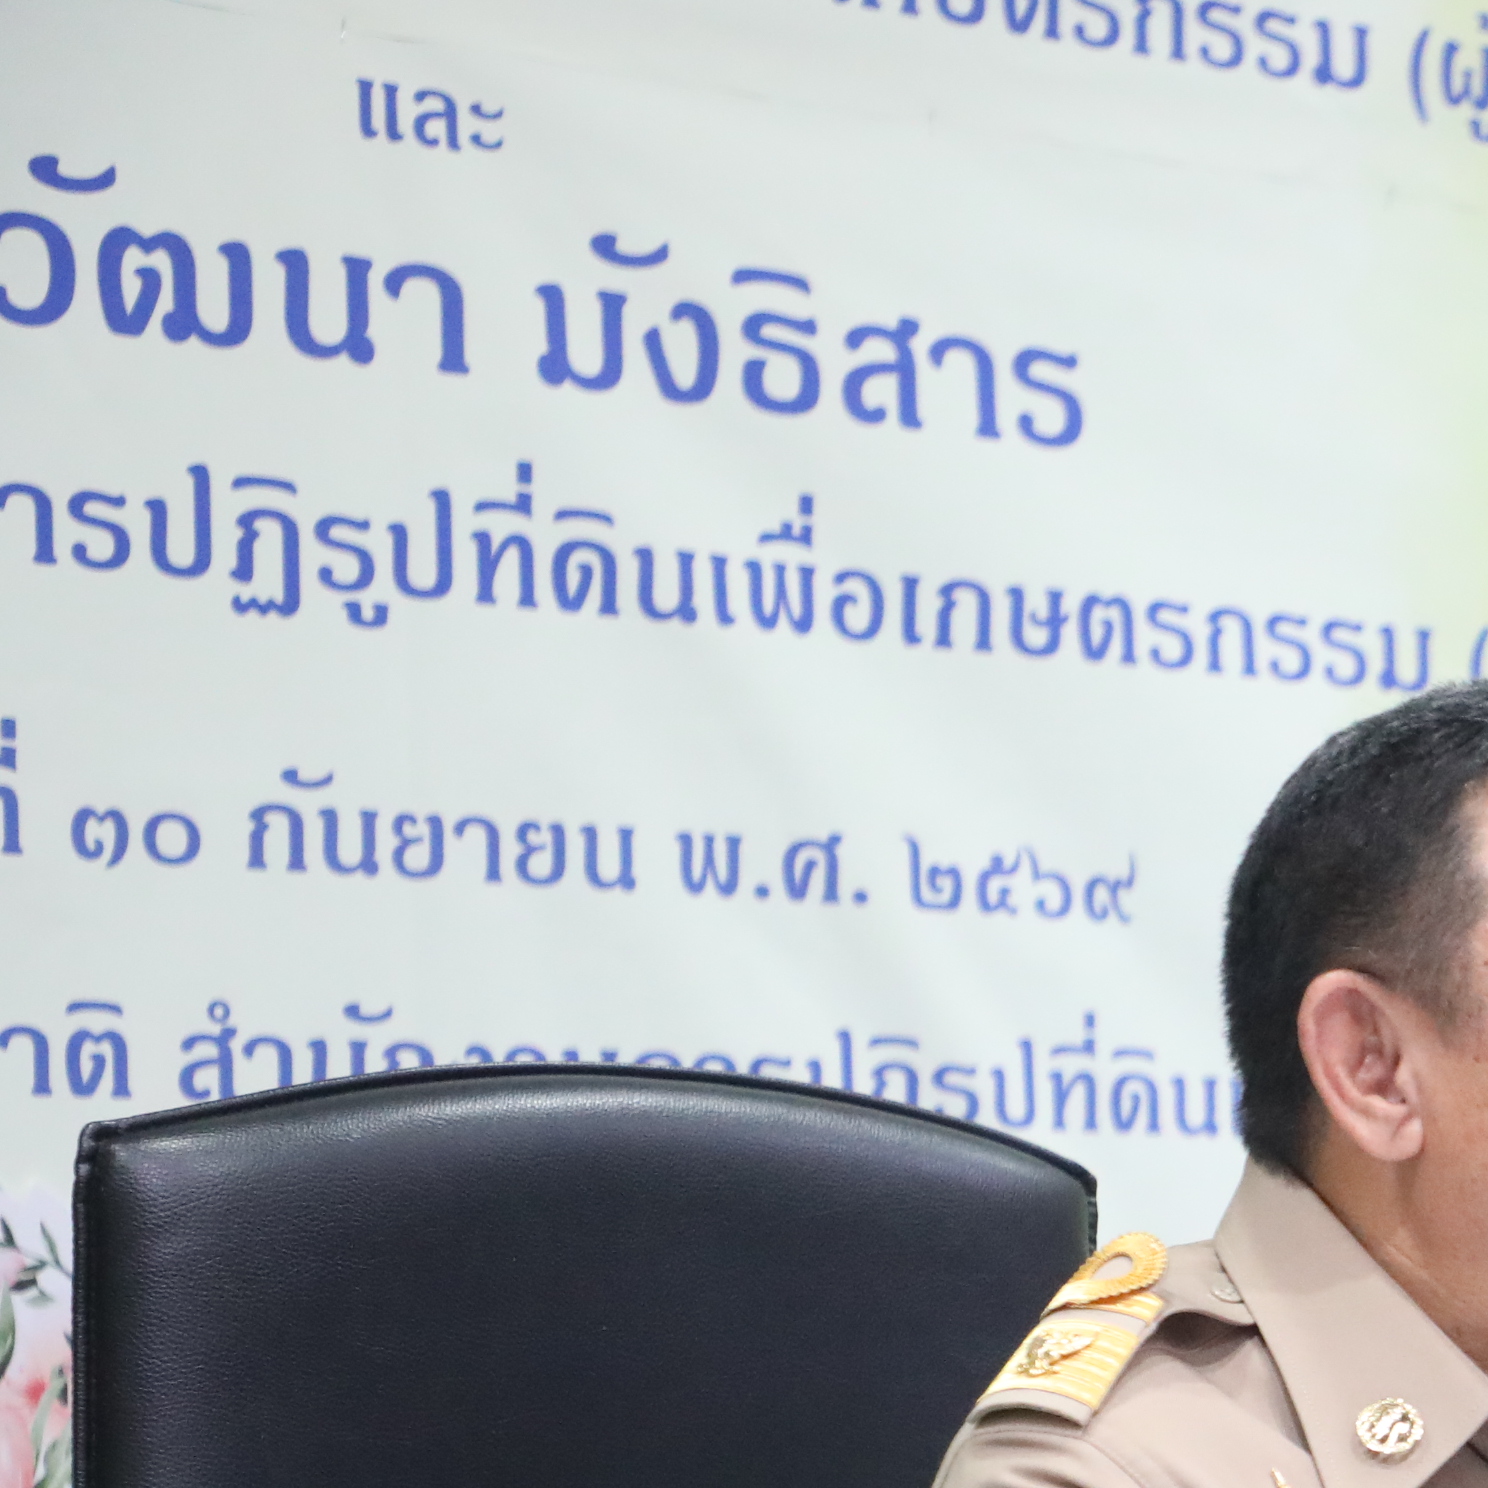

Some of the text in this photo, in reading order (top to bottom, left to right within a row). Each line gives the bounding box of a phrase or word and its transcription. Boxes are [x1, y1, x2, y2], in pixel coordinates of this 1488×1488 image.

[357, 78, 504, 151] และ
[536, 232, 1083, 447] มังธิสาร
[71, 806, 201, 869] ๓๐
[247, 767, 637, 891] กันยายน
[676, 831, 869, 904] พ.ศ.
